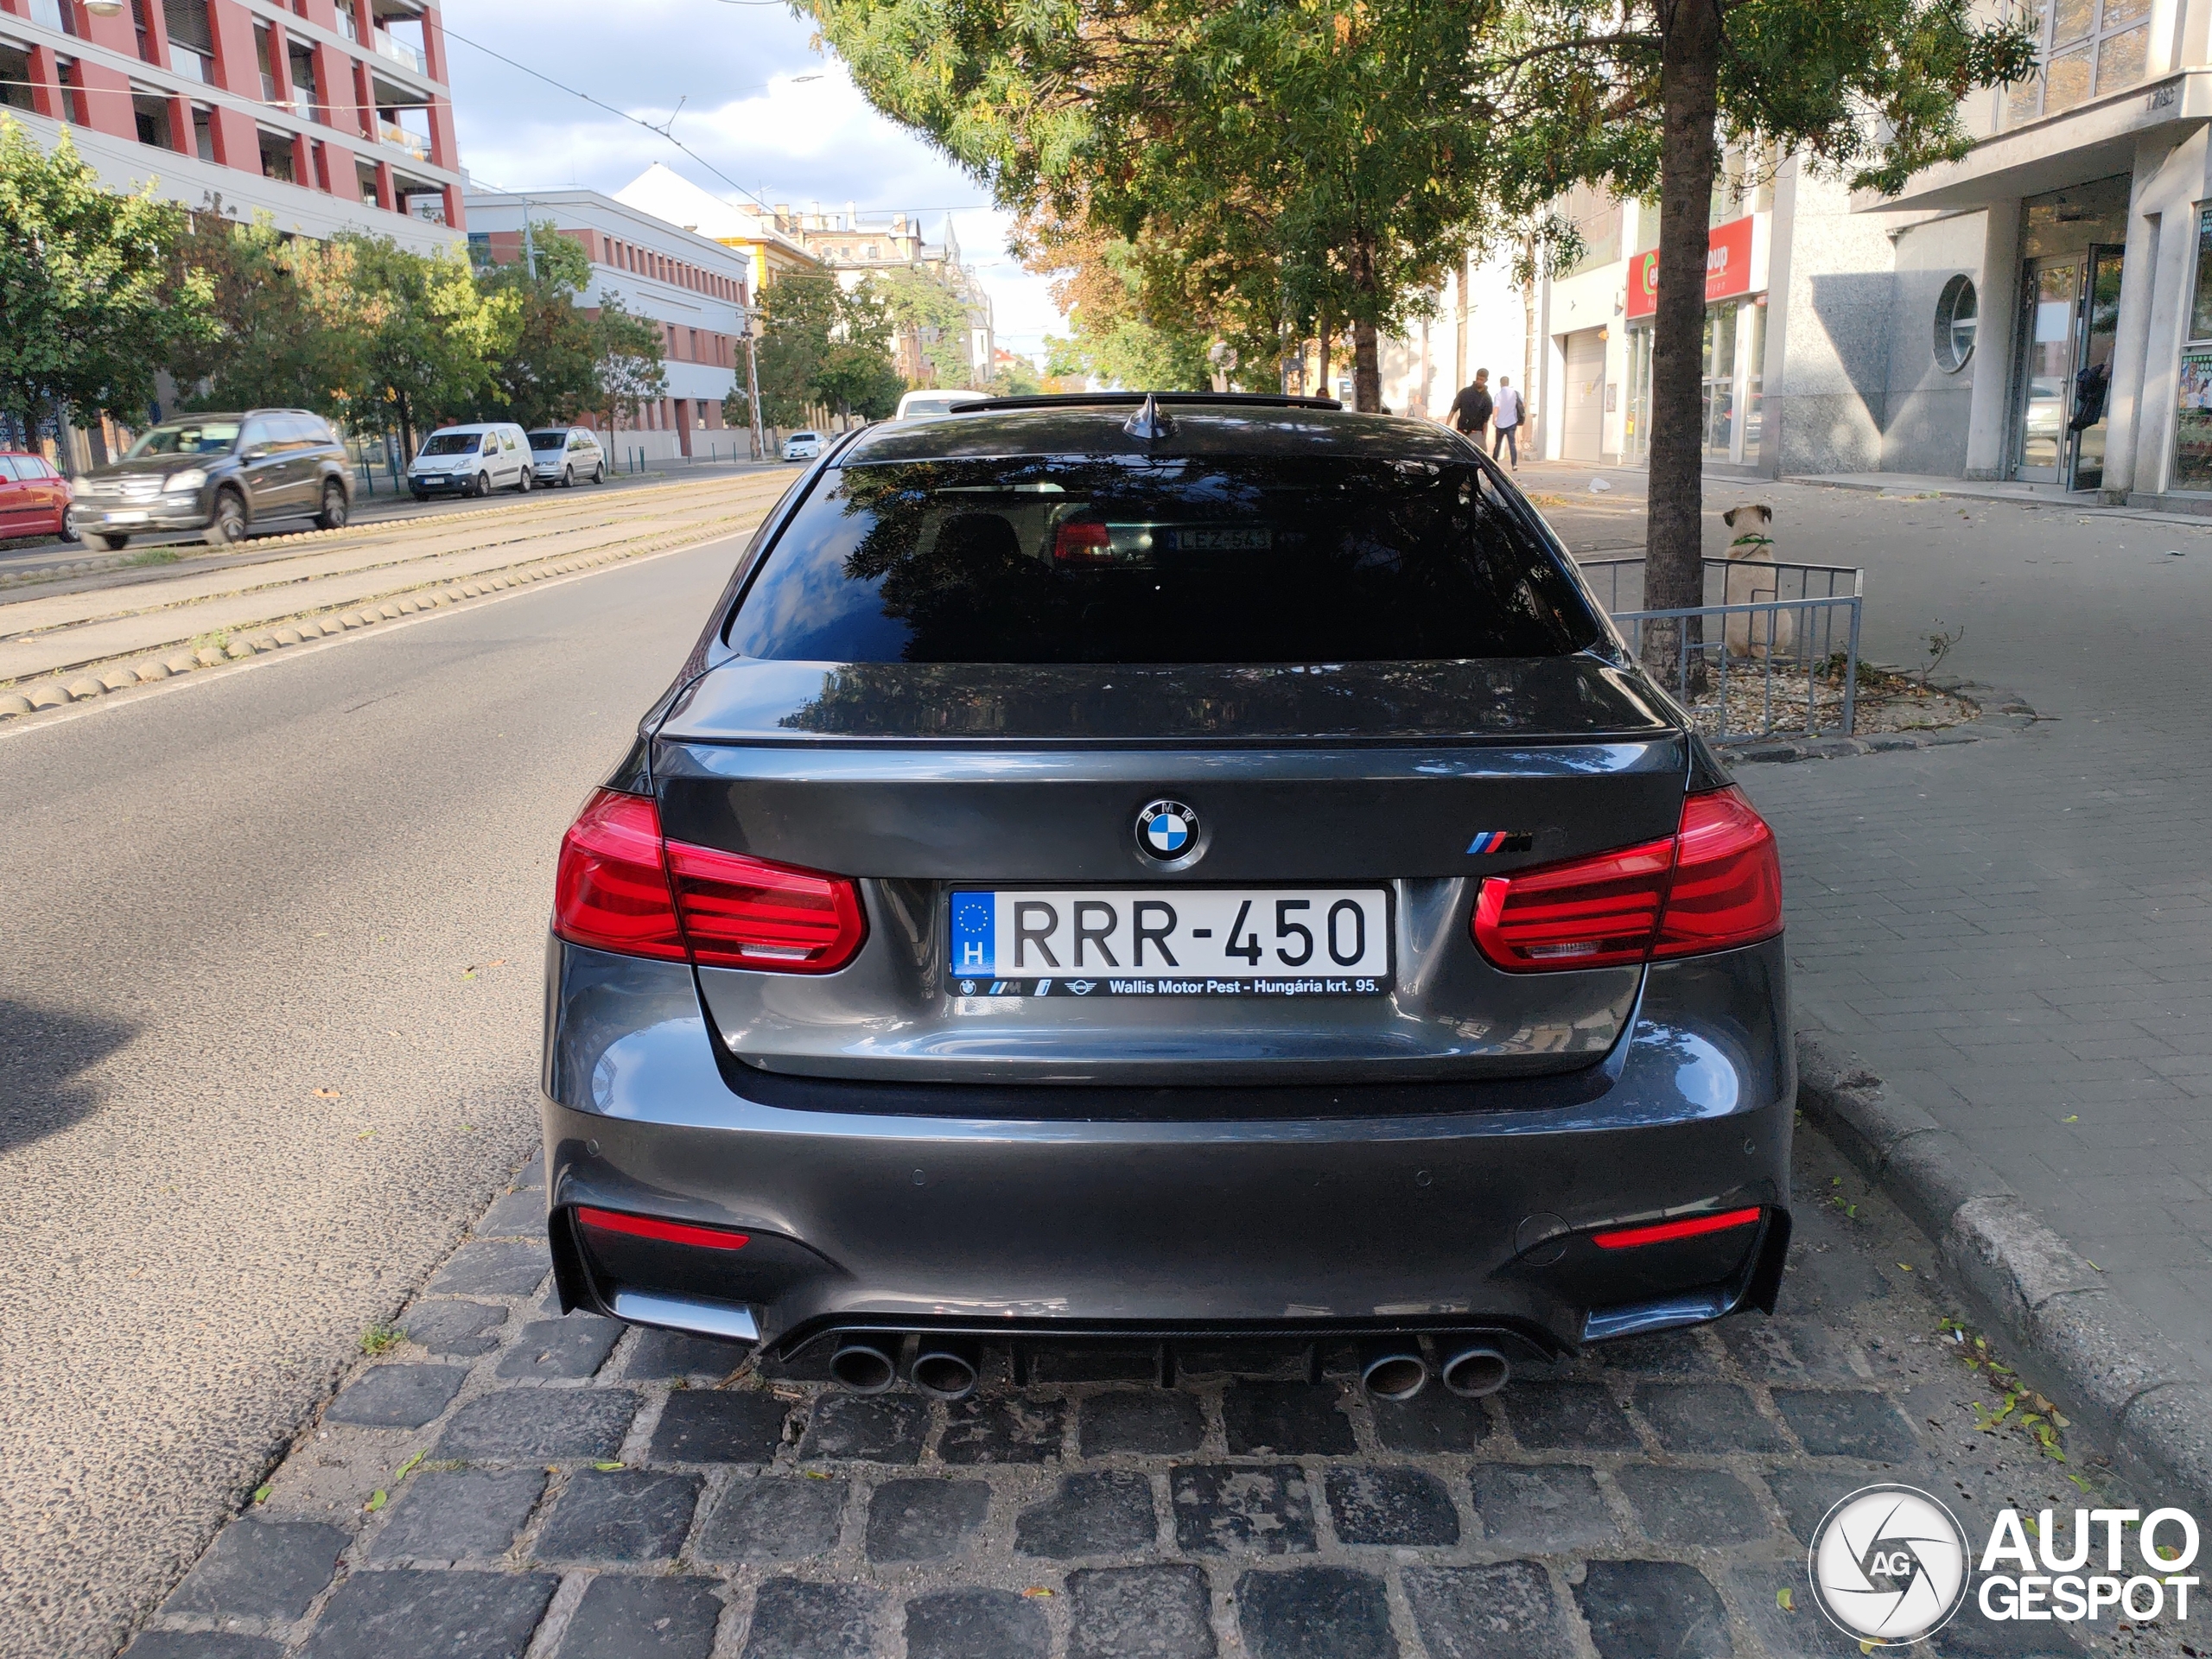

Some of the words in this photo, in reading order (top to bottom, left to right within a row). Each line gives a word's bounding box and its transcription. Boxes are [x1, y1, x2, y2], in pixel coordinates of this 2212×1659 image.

[1141, 803, 1195, 823] BMW
[1014, 899, 1365, 967] RRR-450
[963, 941, 983, 965] H
[1109, 980, 1154, 994] Wallis
[1159, 980, 1204, 994] Motor
[1206, 980, 1241, 994] Pest
[1254, 979, 1323, 995] Hungária
[1326, 979, 1352, 993] krt.
[1355, 979, 1379, 993] 95.
